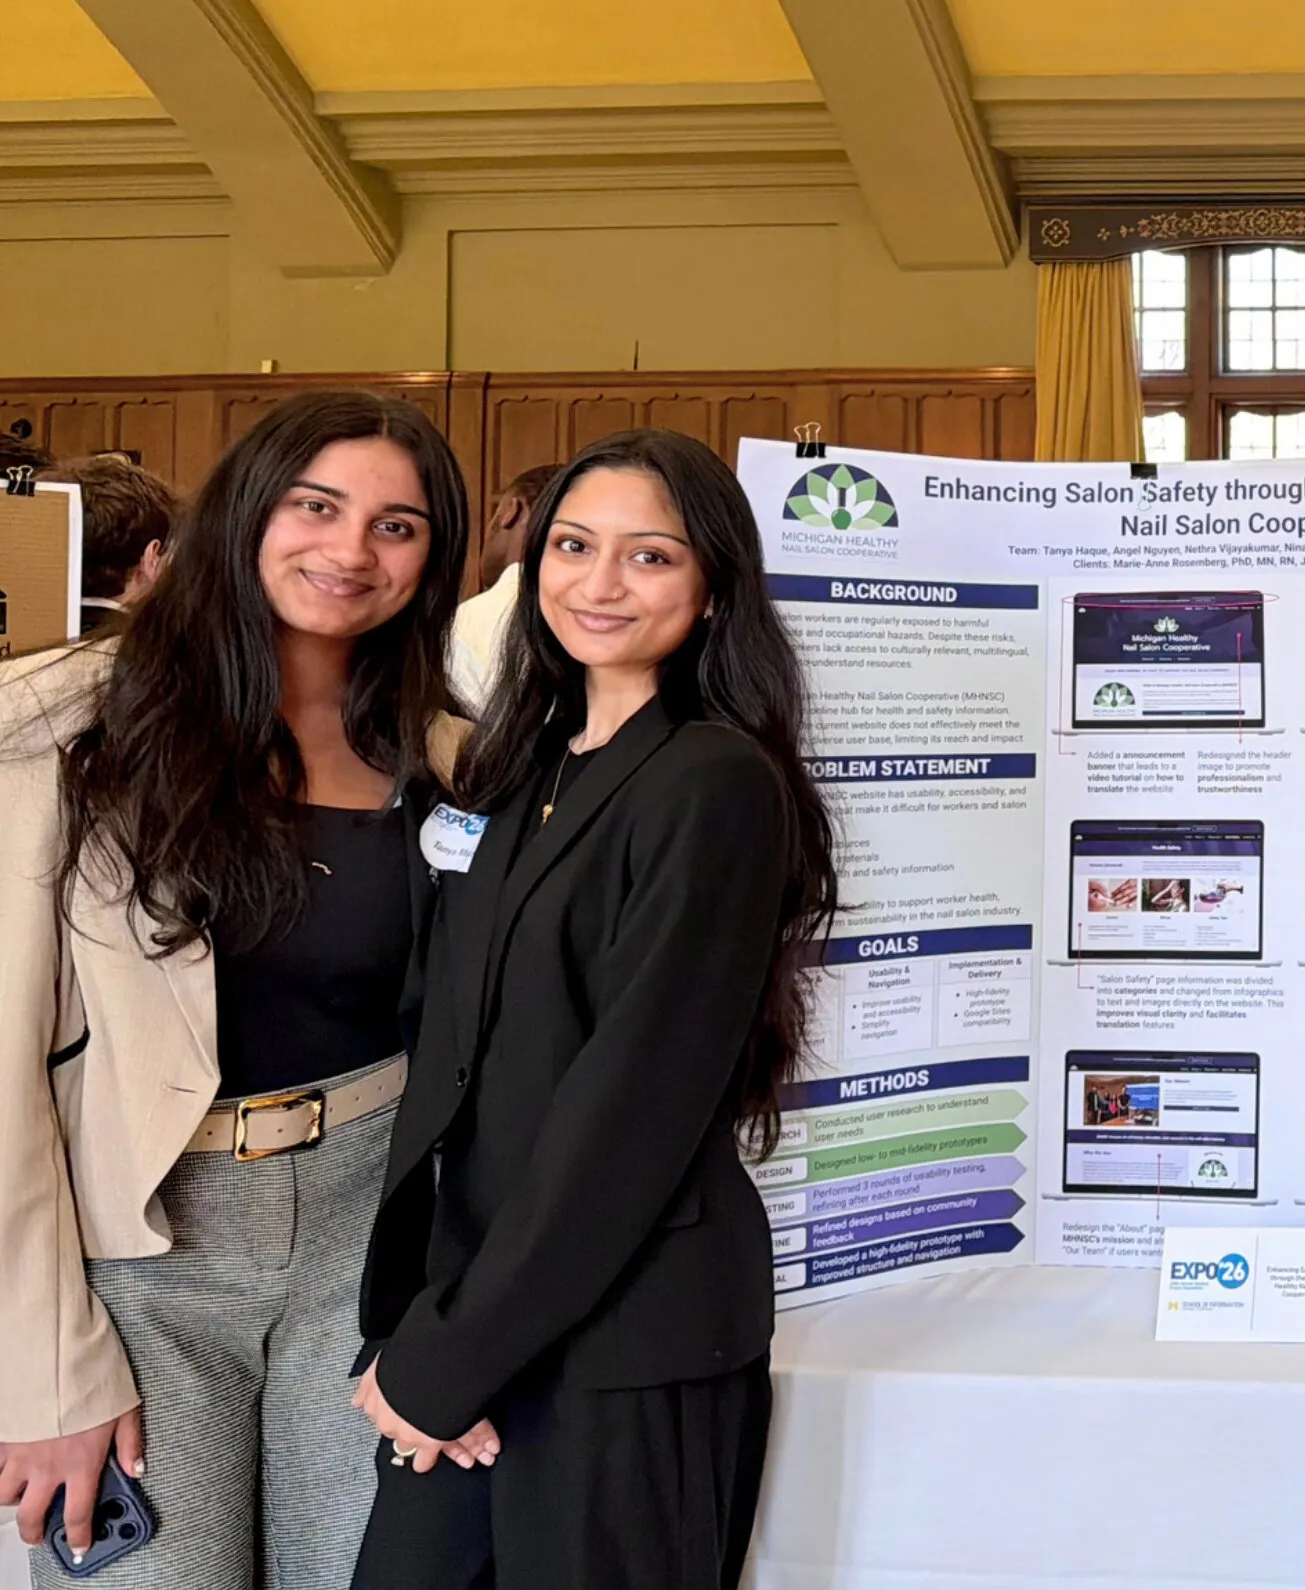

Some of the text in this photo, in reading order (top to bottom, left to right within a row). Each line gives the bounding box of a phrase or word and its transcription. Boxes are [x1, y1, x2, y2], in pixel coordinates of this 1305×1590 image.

[925, 476, 1057, 508] Enhancing
[1065, 482, 1134, 503] Salon
[1141, 481, 1218, 506] Safety
[1121, 515, 1167, 536] Nail
[1175, 513, 1240, 535] Salon
[782, 532, 899, 548] MICHIGAN HEALTHY
[782, 544, 898, 559] NAIL SALON COOPERATIVE
[1008, 545, 1040, 555] Team:
[1043, 546, 1074, 557] Tanya
[1076, 546, 1110, 557] Haque,
[1112, 546, 1142, 557] Angel
[1143, 546, 1182, 556] Nguyen,
[1184, 544, 1217, 554] Nethra
[1219, 543, 1282, 555] Vijayakumar,
[1073, 559, 1111, 569] Clients:
[1113, 559, 1170, 568] Marie-Anne
[1172, 558, 1229, 568] Rosemberg,
[1231, 557, 1254, 567] PhD,
[1256, 557, 1277, 567] MN,
[1280, 556, 1298, 567] RN,
[831, 582, 958, 602] BACKGROUND
[804, 614, 990, 628] workers are regularly exposed to harmful
[1132, 634, 1200, 645] Michigan Healthy
[819, 691, 1005, 702] Healthy Nail Salon Cooperative (MHNSC)
[1087, 751, 1114, 759] Added
[1197, 751, 1292, 761] Redesigned the header
[803, 758, 992, 777] ROBLEM STATEMENT
[858, 936, 919, 957] GOALS
[840, 1070, 930, 1097] METHODS
[814, 1096, 989, 1130] Conducted user research to understand
[814, 1127, 864, 1143] user needs
[756, 1166, 793, 1179] DESIGN
[812, 1198, 978, 1234] Refined designs based on community
[813, 1232, 854, 1247] feedback
[812, 1229, 985, 1270] Developed a high-fidelity prototype with
[1266, 1266, 1300, 1274] Enhancing
